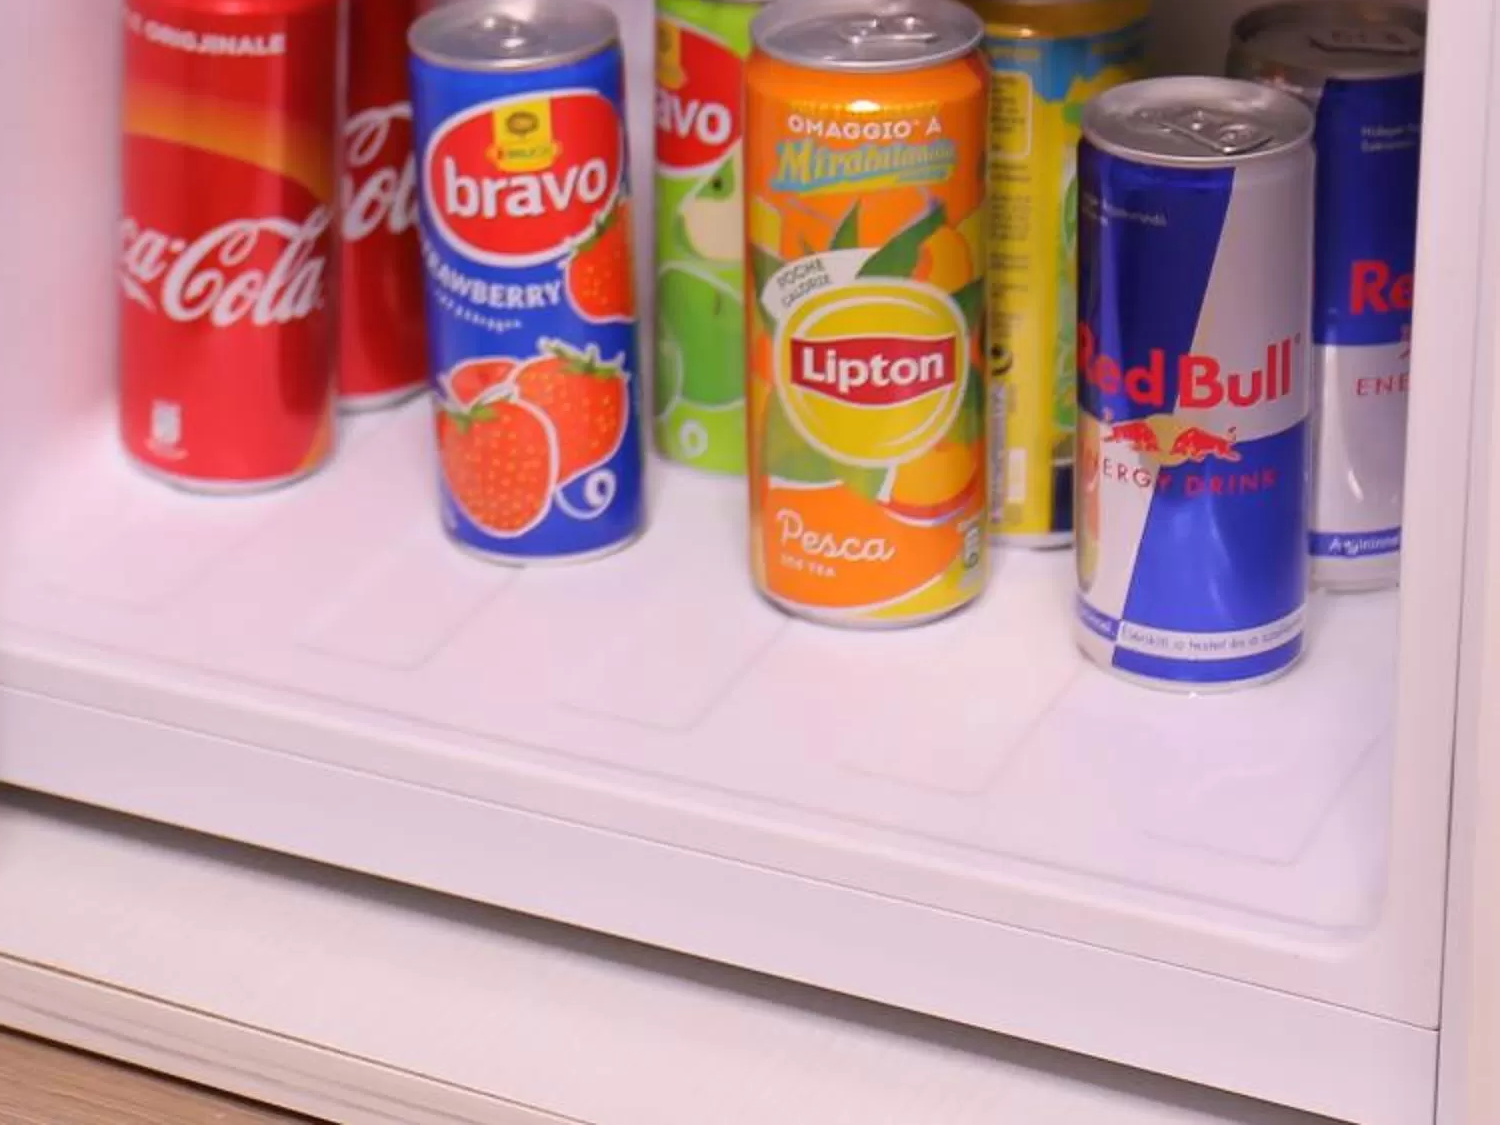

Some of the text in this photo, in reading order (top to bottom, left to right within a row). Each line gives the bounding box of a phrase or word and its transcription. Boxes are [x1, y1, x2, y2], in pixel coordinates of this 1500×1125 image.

[655, 89, 733, 144] avo
[787, 113, 941, 140] OMAGGIO A
[444, 155, 608, 219] bravo
[1350, 260, 1414, 315] Re
[802, 347, 944, 395] Lipton
[1178, 336, 1292, 409] Bull
[1356, 376, 1409, 395] ENE
[776, 508, 896, 562] Pesca
